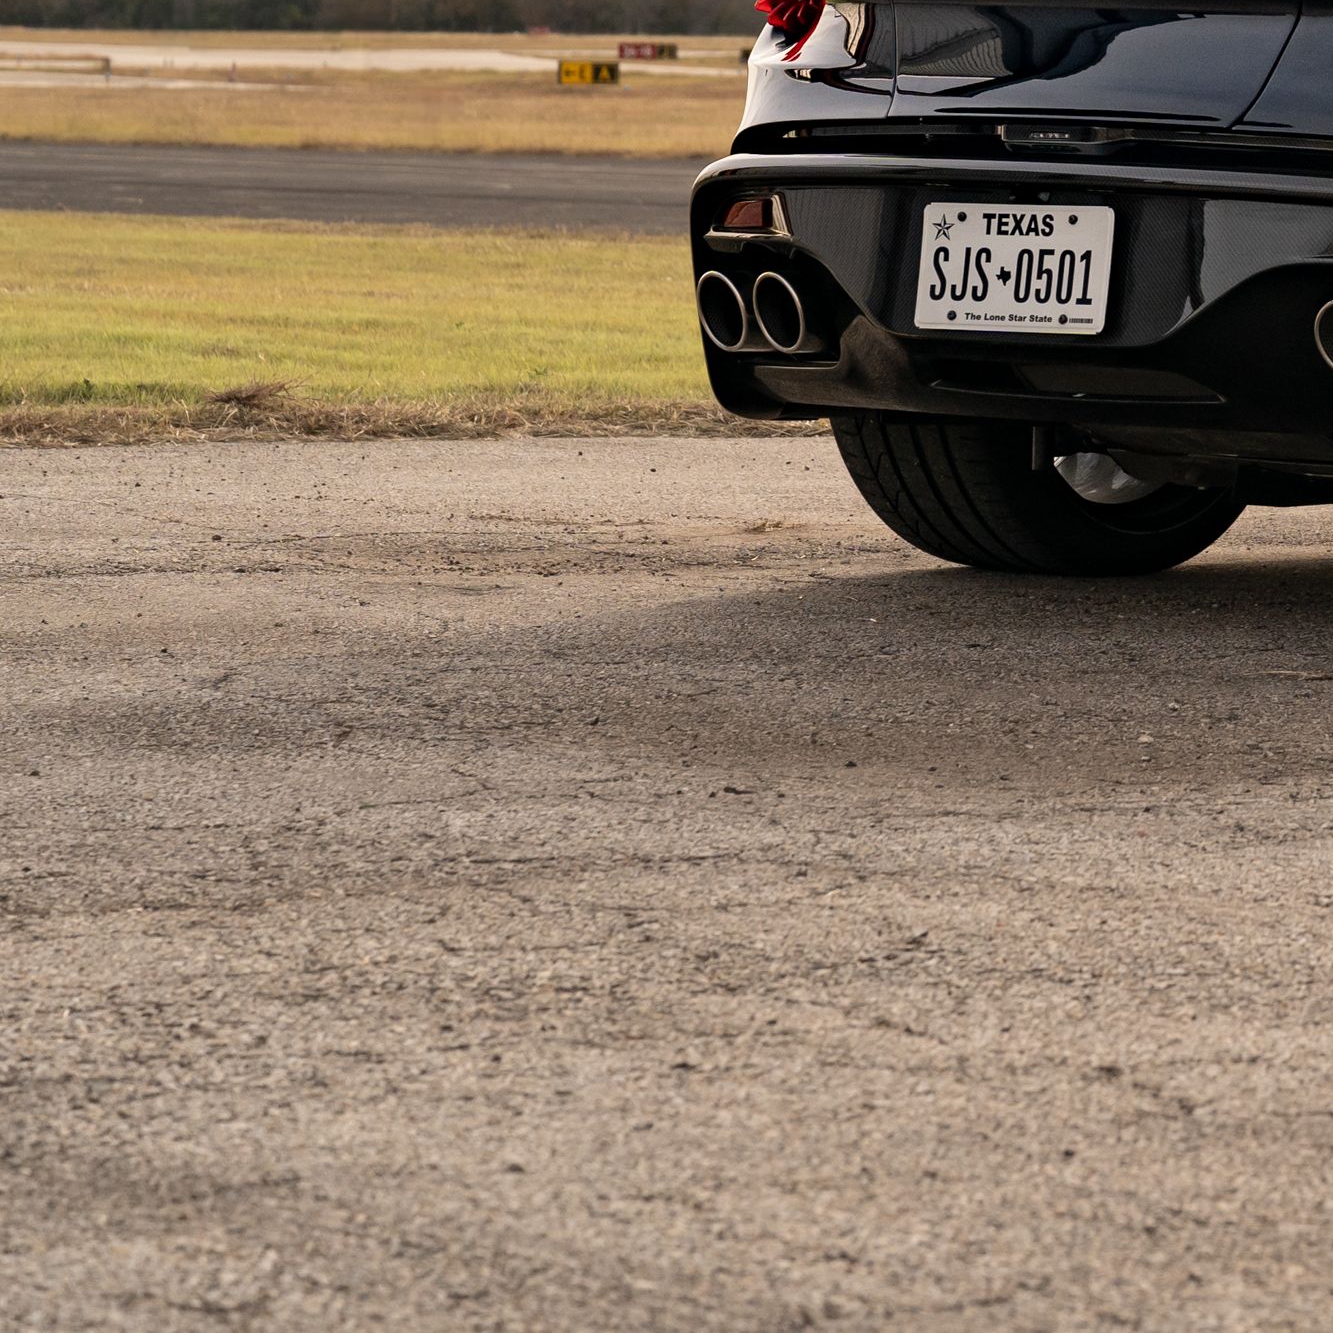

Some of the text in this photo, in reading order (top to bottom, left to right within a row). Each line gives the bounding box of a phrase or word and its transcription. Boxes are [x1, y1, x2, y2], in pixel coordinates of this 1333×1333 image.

[982, 213, 1054, 237] TEXAS
[929, 246, 1093, 306] SJS 0501
[964, 312, 1053, 323] The Lone Star State
